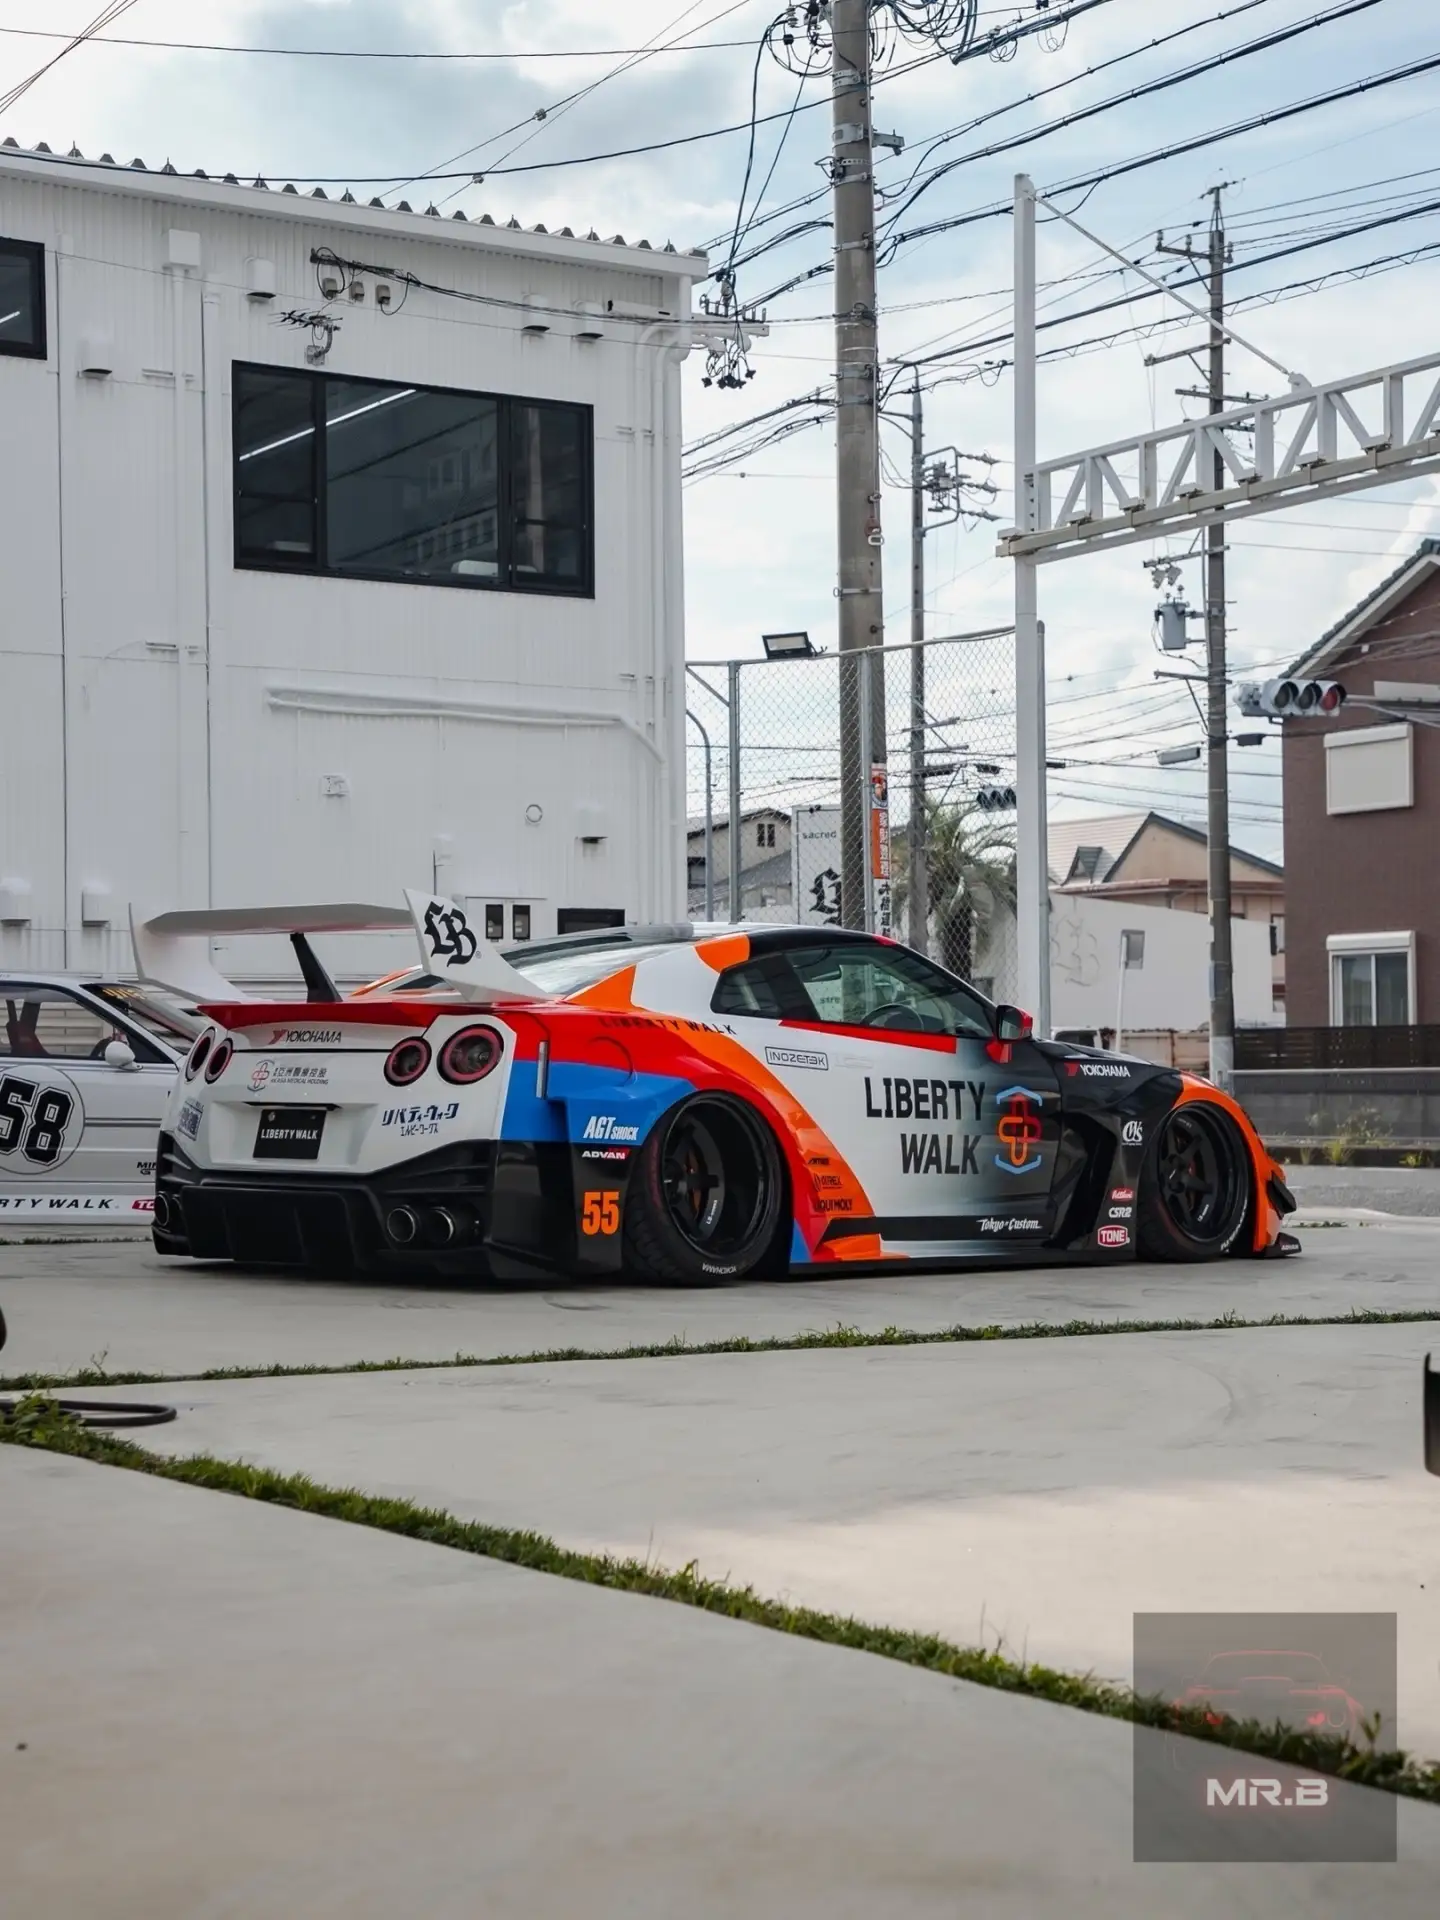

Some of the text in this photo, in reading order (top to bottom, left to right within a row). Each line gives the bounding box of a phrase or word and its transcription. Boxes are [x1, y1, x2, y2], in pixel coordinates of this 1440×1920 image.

[802, 830, 837, 840] sacred
[600, 1016, 737, 1035] LIBERTY WALK
[286, 1029, 342, 1043] YOKOHAMA
[1080, 1064, 1131, 1078] YOKOHAMA
[864, 1077, 986, 1121] LIBERTY
[0, 1073, 75, 1167] 58
[261, 1129, 318, 1140] LIBERTY WALK
[583, 1115, 639, 1141] AGT SHOCK
[582, 1151, 626, 1160] ADVAN
[900, 1133, 982, 1174] WALK
[49, 1199, 114, 1209] WALK
[582, 1191, 619, 1235] 55
[1108, 1207, 1132, 1218] CSR2
[1101, 1230, 1126, 1243] TONE
